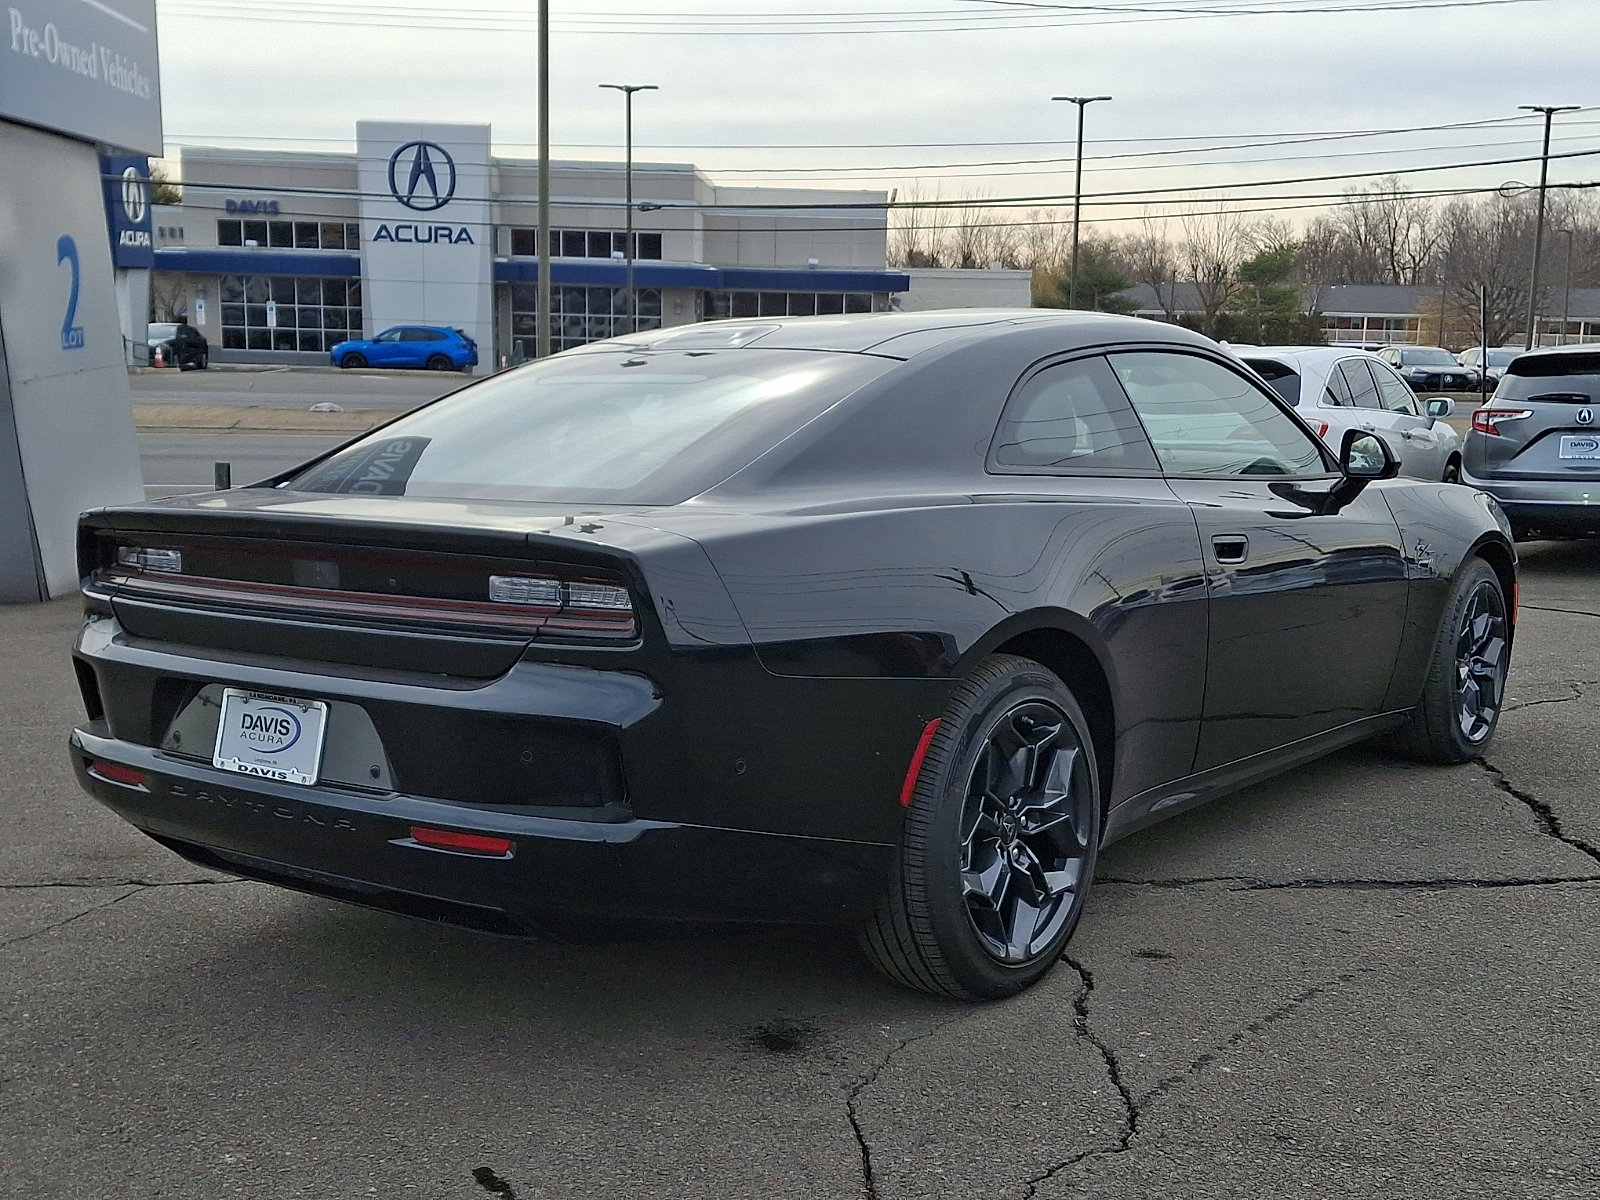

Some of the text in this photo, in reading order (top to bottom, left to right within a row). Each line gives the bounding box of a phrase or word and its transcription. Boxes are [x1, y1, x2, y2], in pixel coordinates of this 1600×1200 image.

[8, 7, 150, 100] Pre-Owned Vehicles
[225, 199, 278, 215] DAVIS
[119, 230, 150, 246] ACURA
[372, 224, 474, 244] ACURA
[57, 234, 83, 345] 2
[63, 331, 83, 346] LOT
[241, 713, 291, 736] DAVIS
[240, 731, 284, 745] ACURA
[237, 764, 288, 780] DAVIS
[170, 785, 357, 831] DAYTONA
